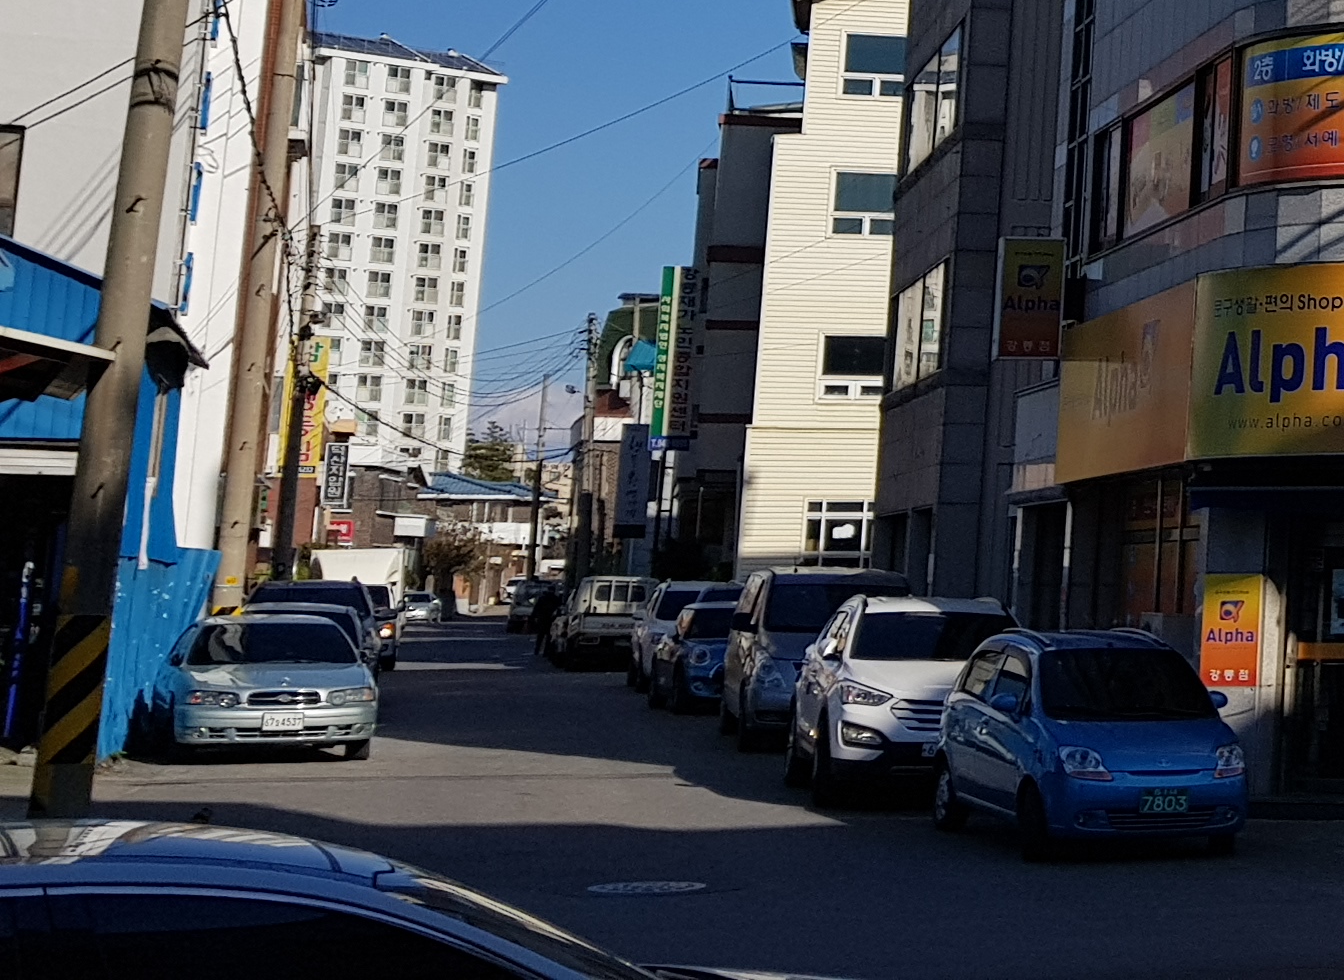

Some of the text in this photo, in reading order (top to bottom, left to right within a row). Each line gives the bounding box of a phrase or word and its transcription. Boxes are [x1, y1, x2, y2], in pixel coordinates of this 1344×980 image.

[1253, 56, 1275, 80] 2층
[1003, 295, 1061, 313] Alpha
[1206, 628, 1255, 645] Alpha
[1142, 795, 1187, 812] 7803
